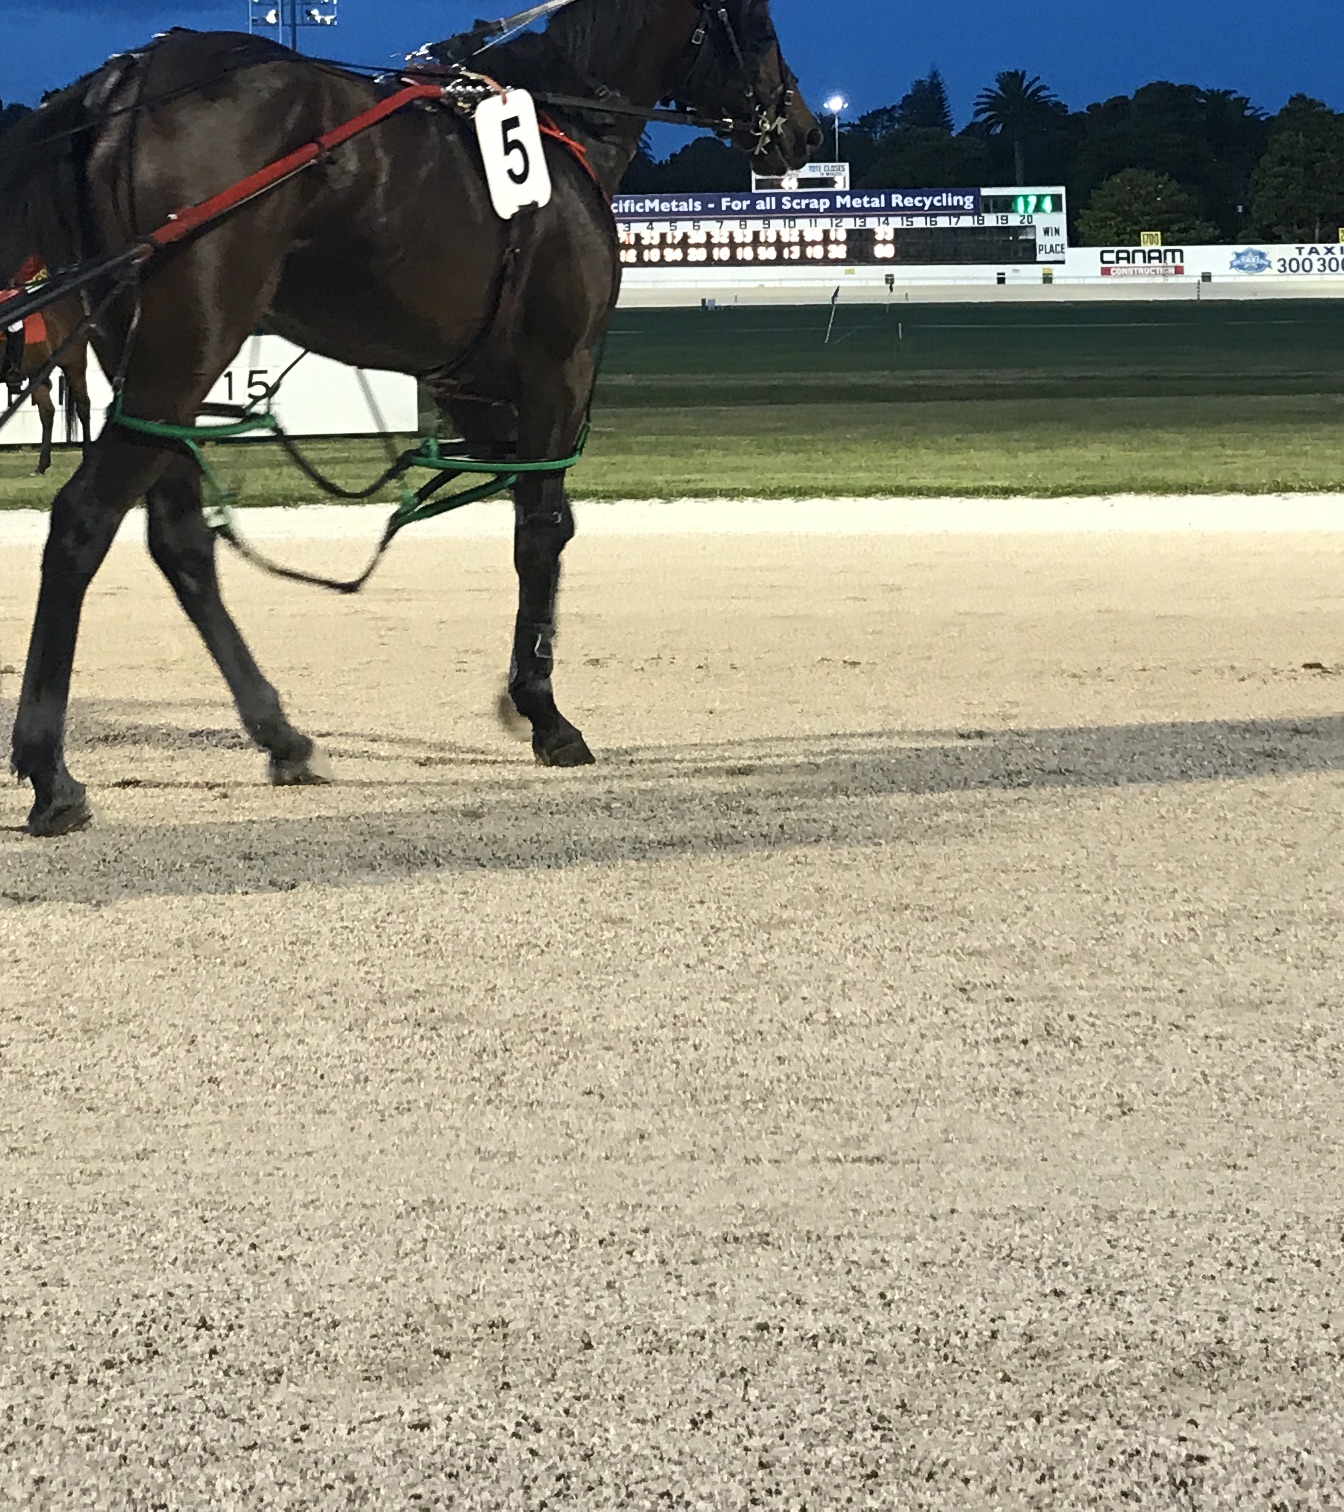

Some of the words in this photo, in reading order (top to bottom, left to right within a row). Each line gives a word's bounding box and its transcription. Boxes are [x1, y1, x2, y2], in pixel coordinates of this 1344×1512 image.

[501, 115, 530, 185] 5
[721, 197, 751, 211] For
[756, 196, 776, 210] all
[781, 196, 831, 213] Scrap
[836, 194, 885, 208] Metal
[891, 193, 975, 210] Recycling
[623, 223, 631, 232] 3
[646, 221, 654, 231] 4
[669, 221, 677, 231] 5
[693, 220, 701, 230] 6
[716, 220, 724, 229] 7
[739, 220, 747, 229] 8
[762, 219, 770, 229] 9
[783, 219, 796, 228] 10
[809, 218, 817, 228] 11
[830, 218, 843, 227] 12
[853, 217, 867, 227] 13
[877, 217, 890, 227] 14
[901, 217, 913, 226] 15
[925, 216, 937, 226] 16
[948, 216, 960, 225] 17
[972, 215, 985, 225] 18
[996, 215, 1008, 224] 19
[1019, 215, 1033, 224] 20
[1042, 226, 1060, 236] WIN
[1038, 243, 1066, 254] PLACE
[1295, 246, 1344, 255] TAXI
[1100, 249, 1184, 264] CANAM
[1277, 257, 1313, 273] 300
